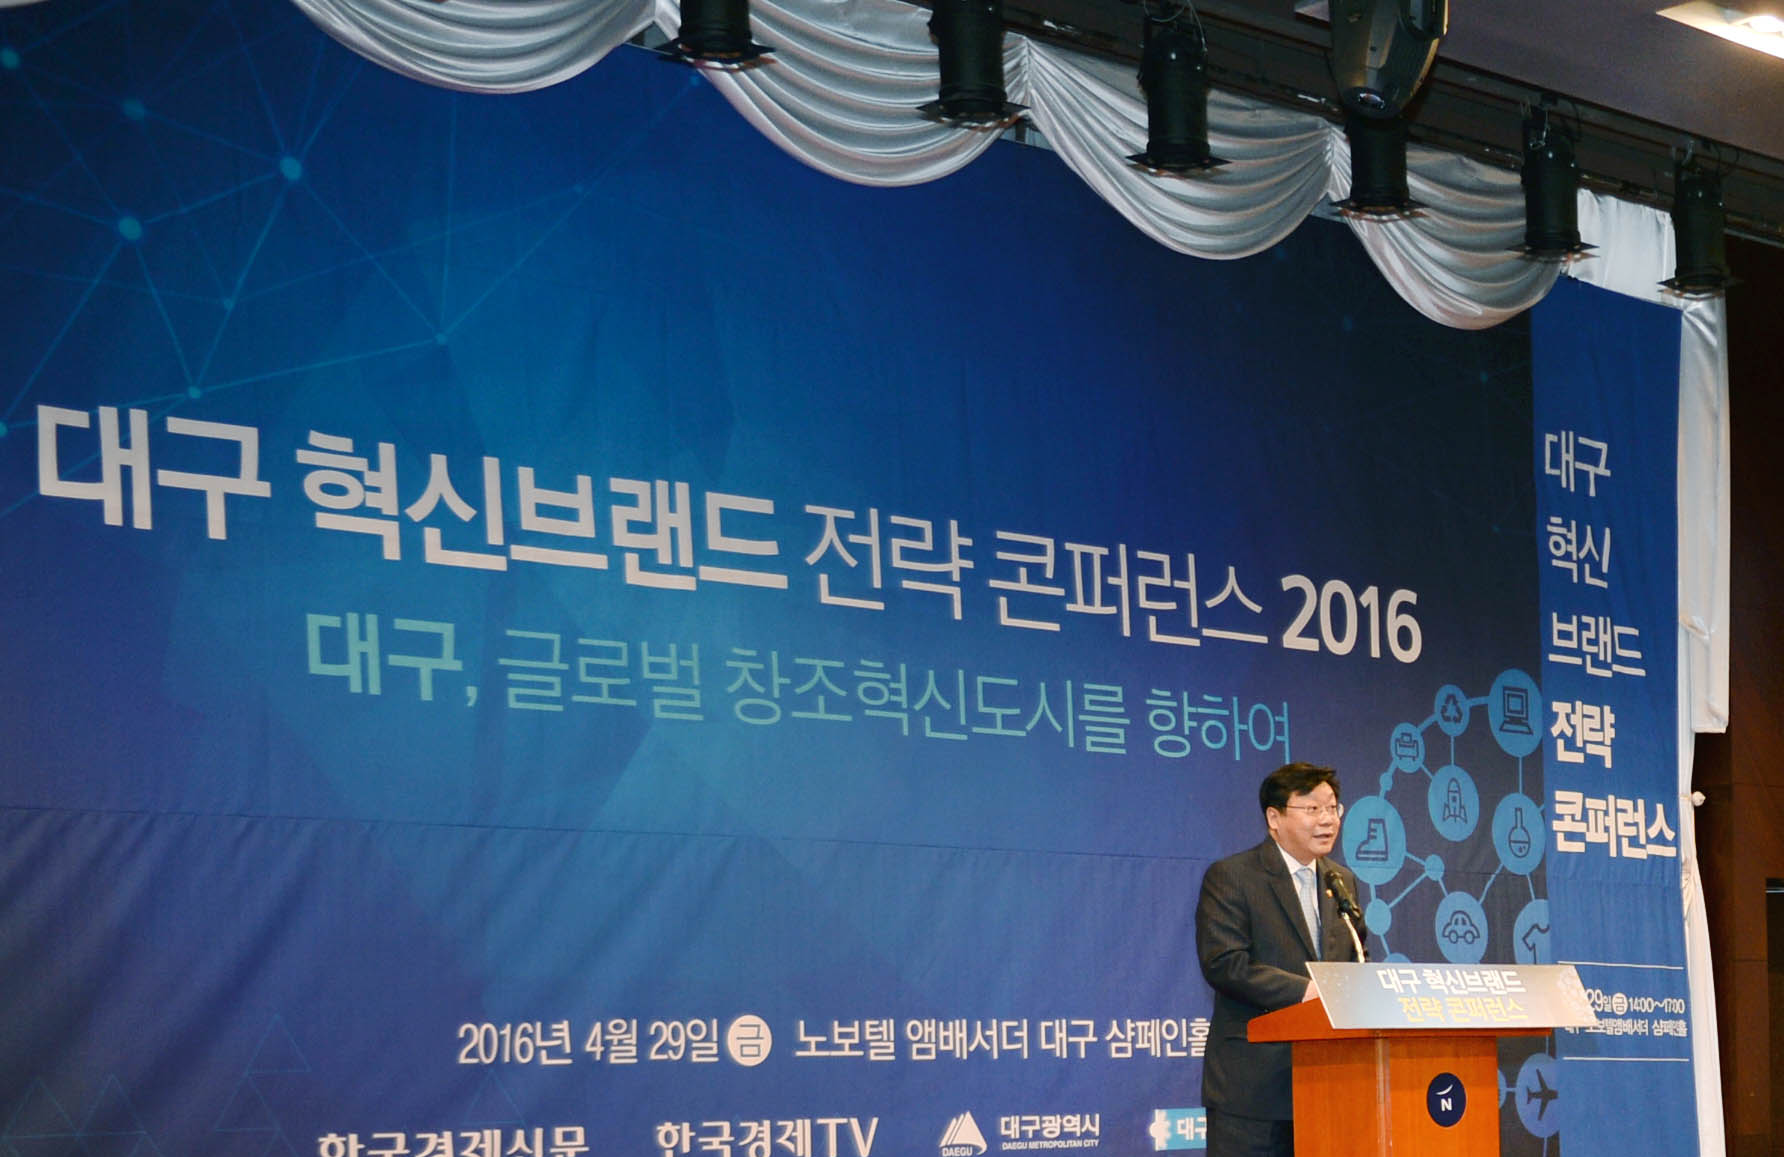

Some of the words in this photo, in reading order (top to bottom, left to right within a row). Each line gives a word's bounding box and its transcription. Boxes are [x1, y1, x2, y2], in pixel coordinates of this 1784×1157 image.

[1544, 430, 1611, 497] 대구
[37, 404, 271, 540] 대구
[296, 430, 789, 590] 혁신브랜드
[804, 503, 975, 621] 전략
[988, 530, 1269, 647] 콘퍼런스
[1281, 574, 1423, 664] 2016
[1547, 516, 1611, 588] 혁신
[1548, 613, 1646, 677] 브랜드
[306, 612, 478, 707] 대구,
[498, 628, 705, 721] 글로벌
[725, 646, 1130, 755] 창조혁신도시를
[1146, 686, 1291, 763] 향하여
[1550, 701, 1616, 768] 전략
[1552, 790, 1677, 859] 콘퍼런스
[1376, 968, 1421, 994] 대구
[1422, 968, 1527, 995] 혁신브랜드
[1398, 997, 1446, 1024] 전략
[1447, 997, 1529, 1023] 콘퍼런스
[457, 1019, 573, 1066] 2016년
[585, 1018, 638, 1064] 4월
[649, 1017, 719, 1063] 29일
[795, 1018, 895, 1060] 노보텔
[905, 1017, 1029, 1060] 앰배서더
[1040, 1018, 1098, 1060] 대구
[1105, 1018, 1210, 1058] 샴페인홀
[1000, 1113, 1100, 1139] 대구광역시
[1441, 1097, 1452, 1111] N
[942, 1145, 973, 1157] DAEGU
